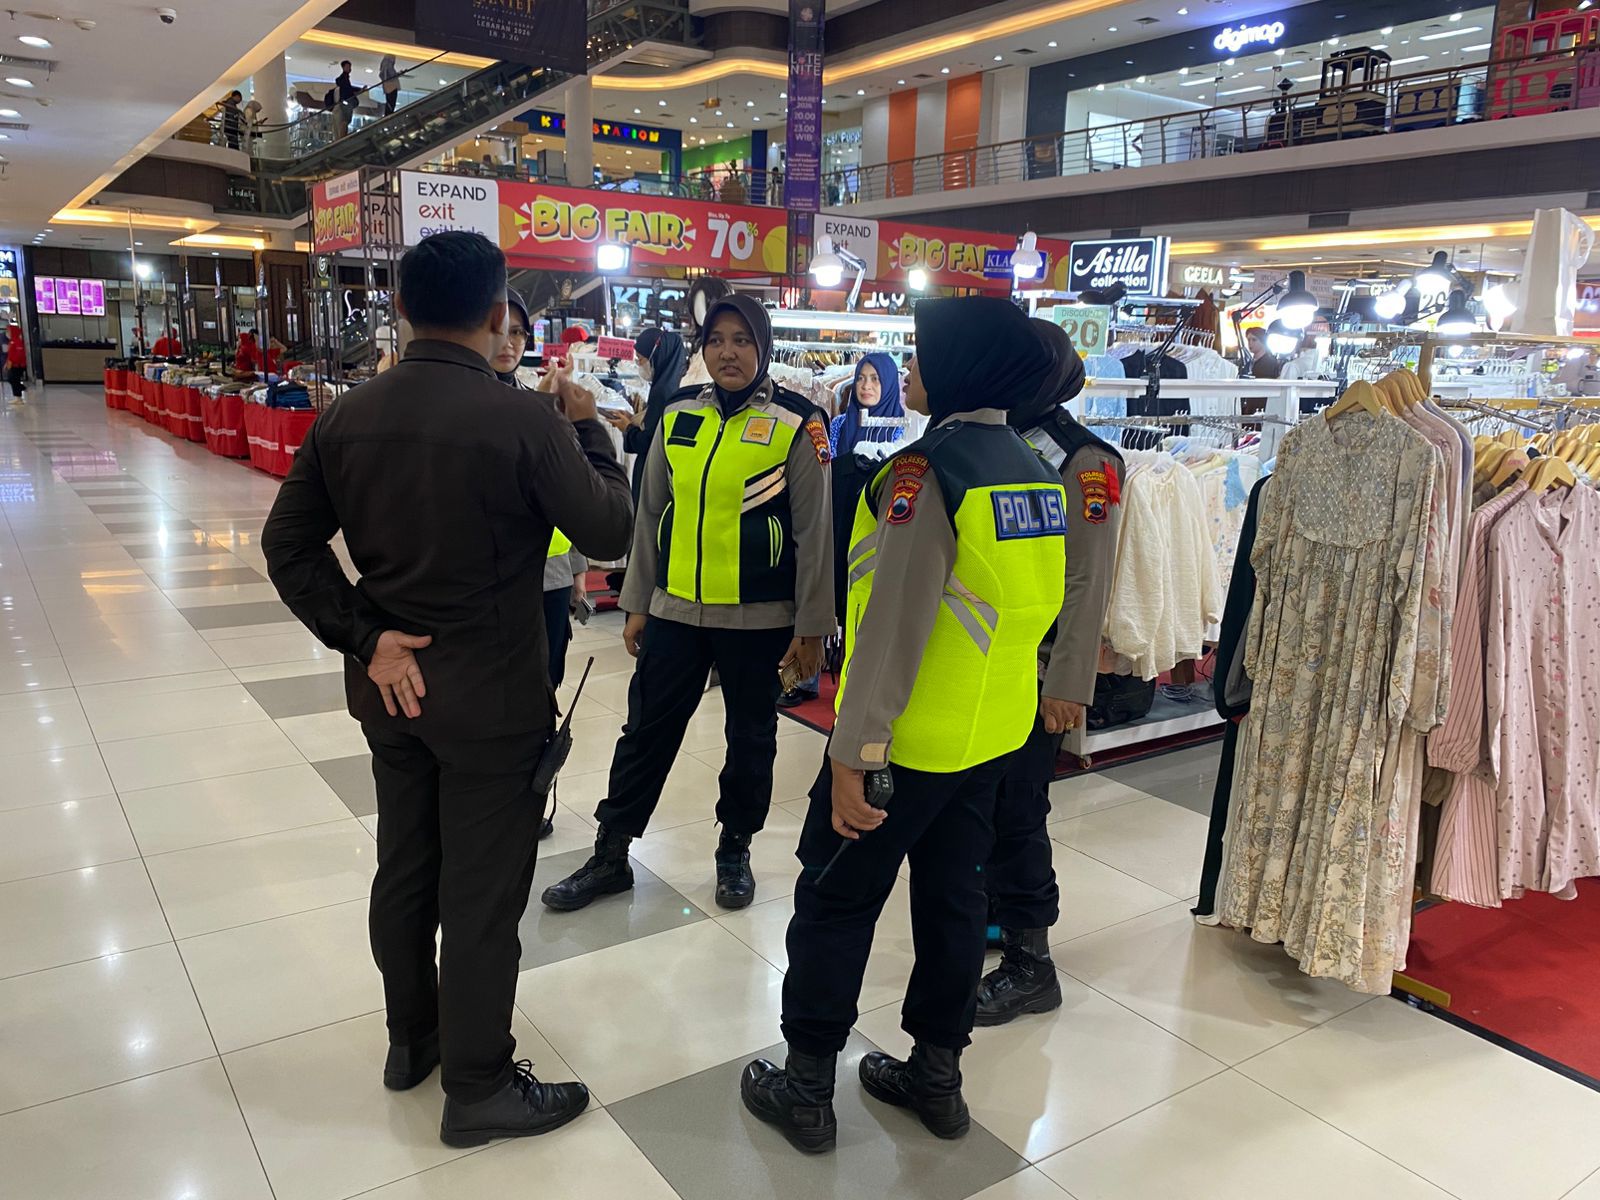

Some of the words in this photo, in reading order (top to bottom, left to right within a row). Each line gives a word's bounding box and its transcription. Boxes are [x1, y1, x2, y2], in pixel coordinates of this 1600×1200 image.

[1213, 21, 1285, 52] digimap
[790, 64, 822, 77] NITE
[592, 123, 660, 142] STATION
[418, 181, 487, 201] EXPAND
[418, 203, 456, 221] exit
[531, 199, 600, 243] BIG
[604, 208, 686, 250] FAIR
[825, 222, 872, 238] EXPAND
[902, 237, 945, 270] BIG
[1074, 246, 1150, 276] Asilla
[1060, 318, 1100, 348] 20
[998, 494, 1066, 529] POLISI
